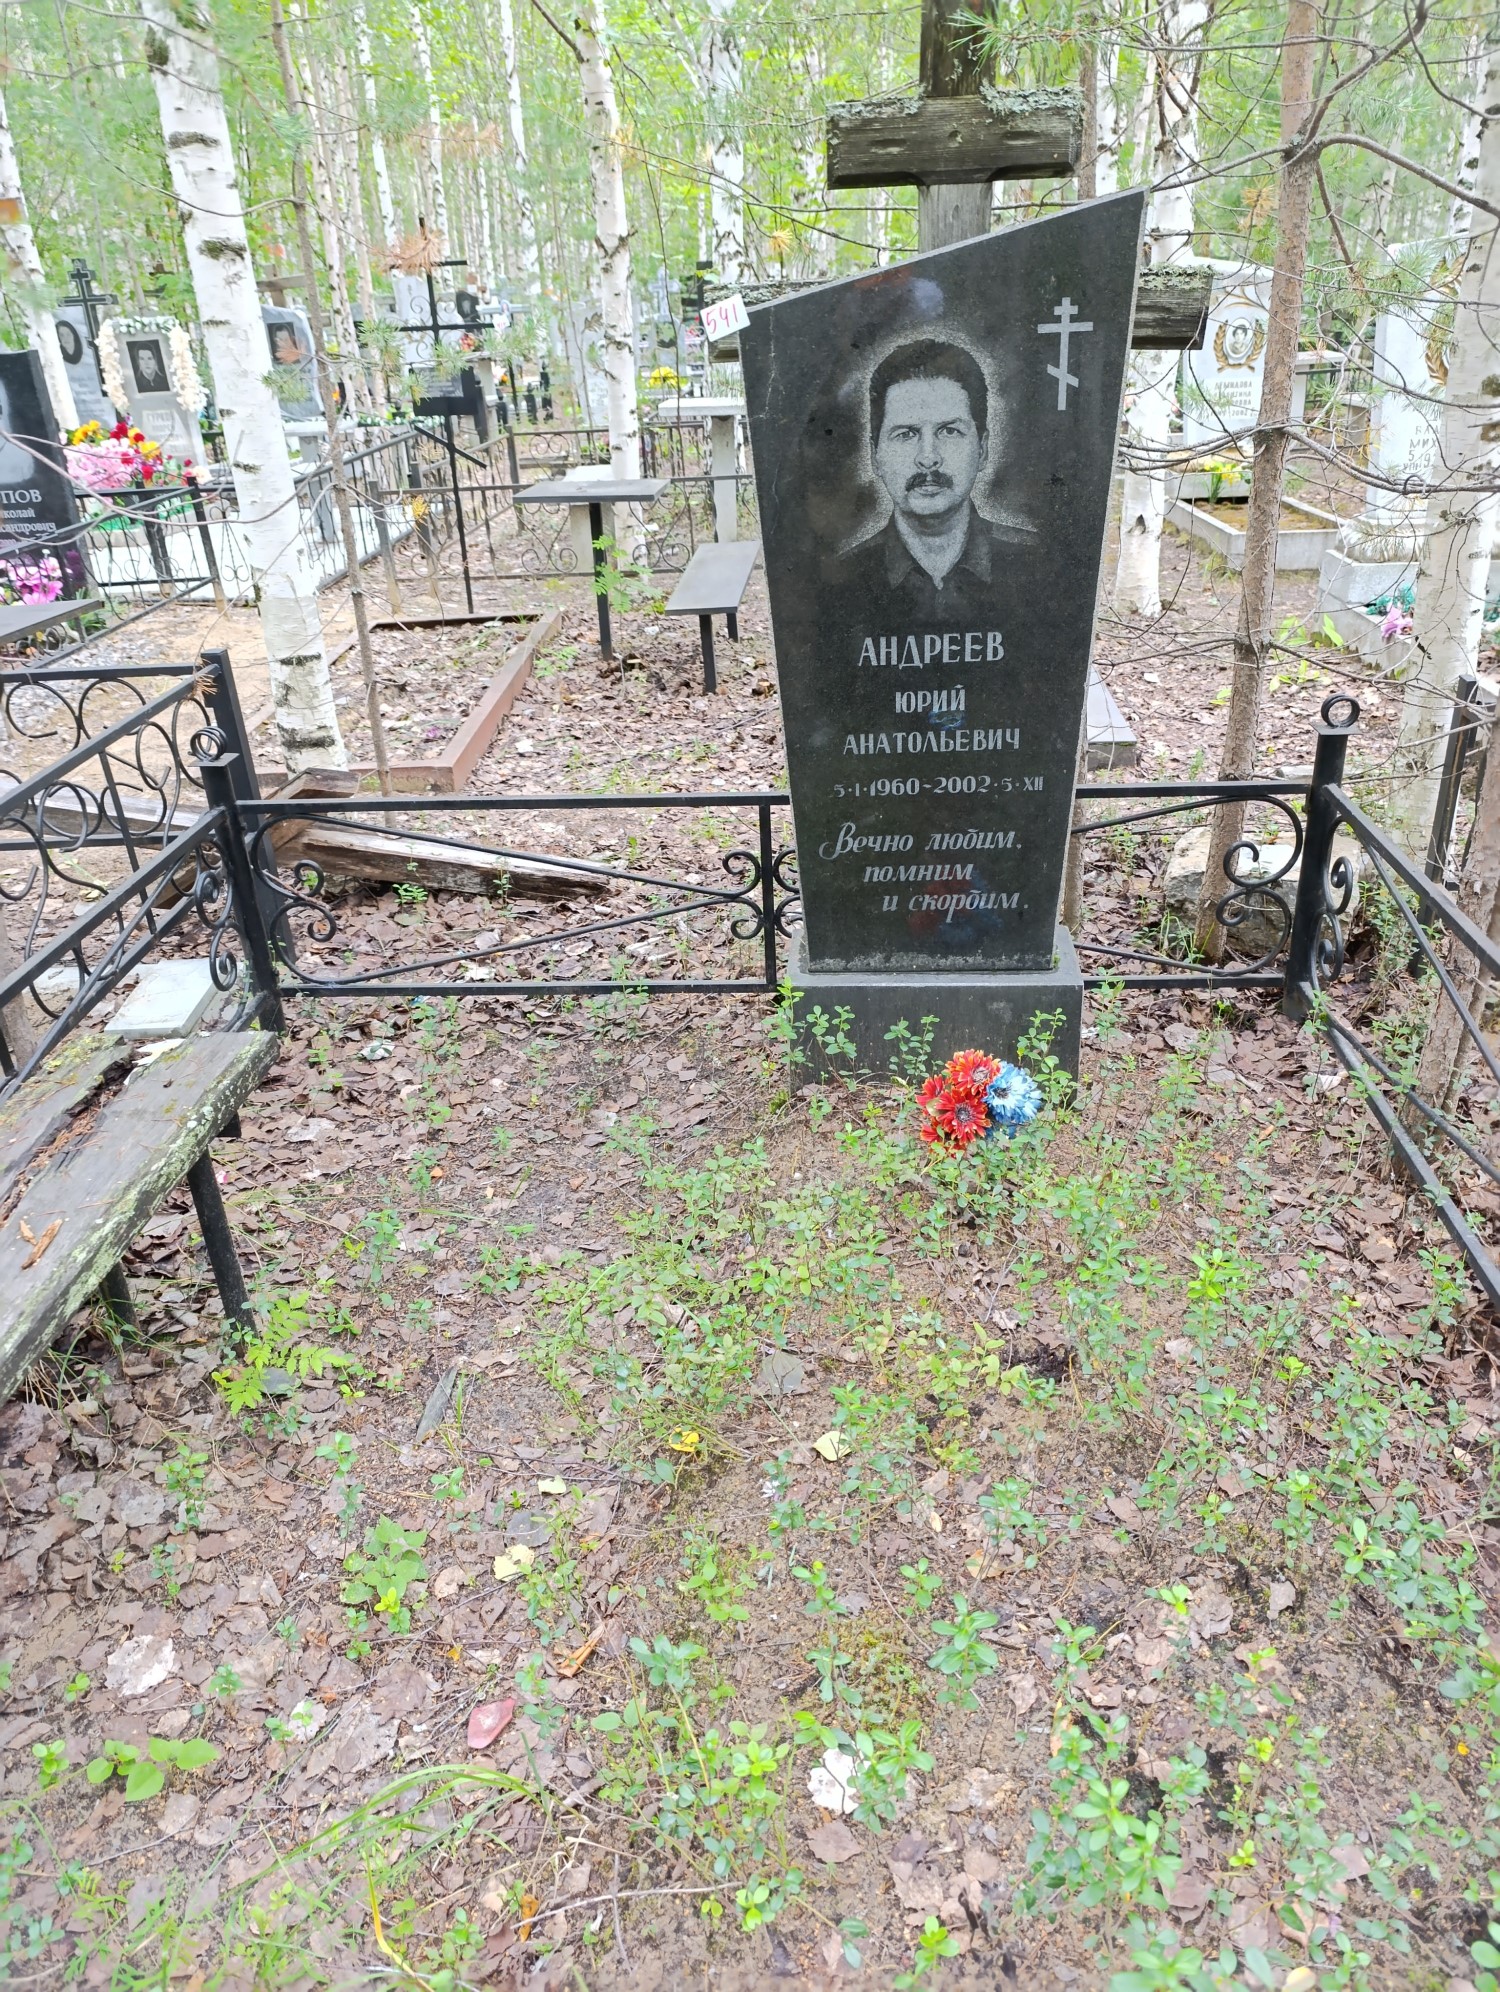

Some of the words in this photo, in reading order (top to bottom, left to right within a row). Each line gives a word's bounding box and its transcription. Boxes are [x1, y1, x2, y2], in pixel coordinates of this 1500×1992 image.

[706, 303, 738, 334] 541
[0, 489, 42, 504] ПОВ
[2, 507, 36, 518] колай
[858, 631, 1005, 670] АНДРЕЕВ
[895, 684, 966, 714] ЮРИЙ
[843, 728, 1020, 755] АНАТОЛЬЕВИЧ
[818, 822, 914, 860] Вечно
[863, 863, 974, 882] помним
[882, 895, 898, 912] и
[908, 889, 1029, 923] скорбим.
